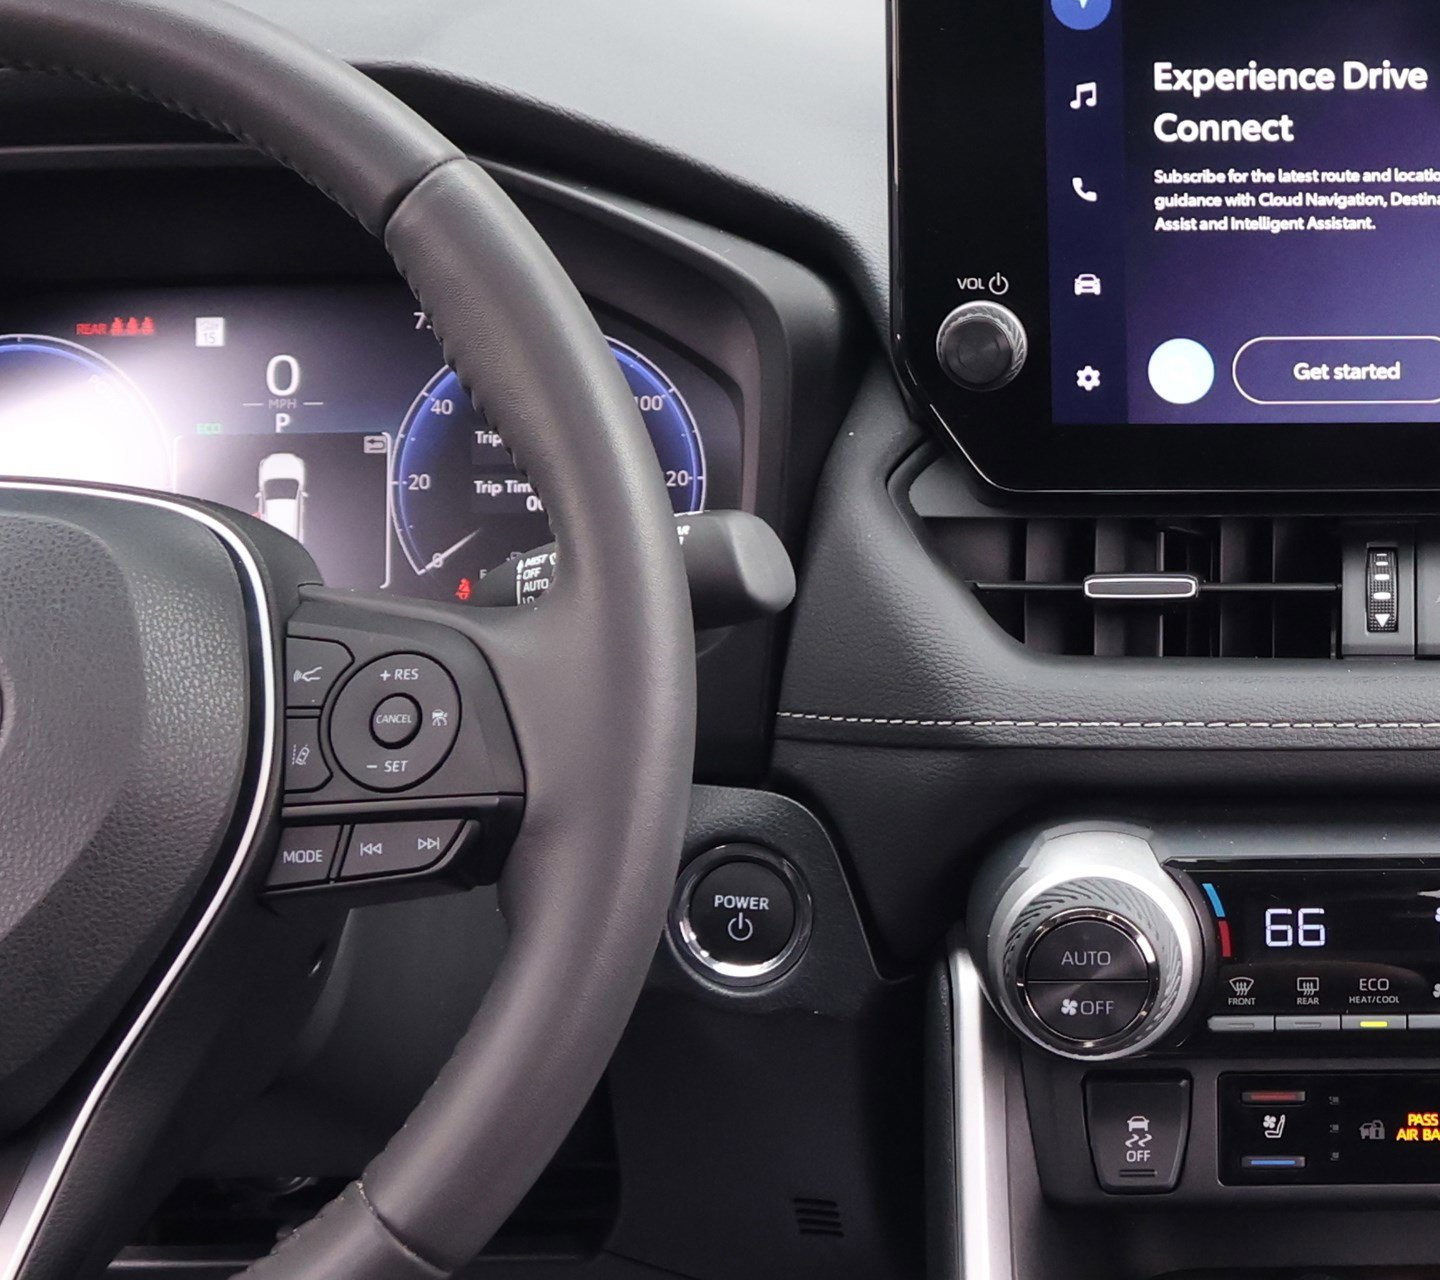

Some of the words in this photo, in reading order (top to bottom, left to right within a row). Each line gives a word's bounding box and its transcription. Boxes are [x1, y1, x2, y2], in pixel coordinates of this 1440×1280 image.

[1153, 60, 1336, 98] Experience
[1343, 60, 1429, 90] Drive
[1153, 113, 1295, 143] Connect
[1154, 168, 1226, 184] Subscribe
[1227, 168, 1248, 184] for
[1250, 168, 1275, 184] the
[1278, 168, 1319, 183] latest
[1321, 169, 1360, 183] route
[1363, 168, 1391, 183] and
[1154, 193, 1222, 211] guidance
[1224, 192, 1255, 207] with
[1258, 192, 1302, 207] Cloud
[1305, 192, 1388, 209] Navigation,
[1154, 216, 1197, 232] Assist
[1199, 216, 1228, 231] and
[1231, 216, 1304, 233] Intelligent
[1307, 216, 1376, 231] Assistant.
[957, 277, 985, 291] VOL
[75, 322, 108, 336] REAR
[266, 355, 301, 396] 0
[1293, 362, 1329, 382] Get
[1333, 361, 1401, 381] started
[268, 398, 297, 409] MPH
[431, 399, 453, 415] 40
[275, 413, 291, 433] P
[475, 431, 503, 447] Trip
[408, 474, 430, 490] 20
[666, 471, 688, 486] 20
[474, 480, 503, 497] Trip
[505, 480, 535, 494] Tim
[523, 579, 549, 592] AUTO
[394, 668, 419, 682] RES
[376, 714, 412, 724] CANCEL
[384, 760, 408, 772] SET
[283, 849, 323, 864] MODE
[714, 894, 769, 911] POWER
[1265, 908, 1326, 947] 66
[1061, 949, 1112, 967] AUTO
[1359, 978, 1390, 992] ECO
[1228, 996, 1256, 1006] FRONT
[1296, 996, 1320, 1006] REAR
[1349, 995, 1400, 1005] HEAT/COOL
[1080, 999, 1115, 1018] OFF
[1407, 1112, 1439, 1127] PASS
[1396, 1128, 1419, 1142] AIR
[1125, 1150, 1151, 1163] OFF
